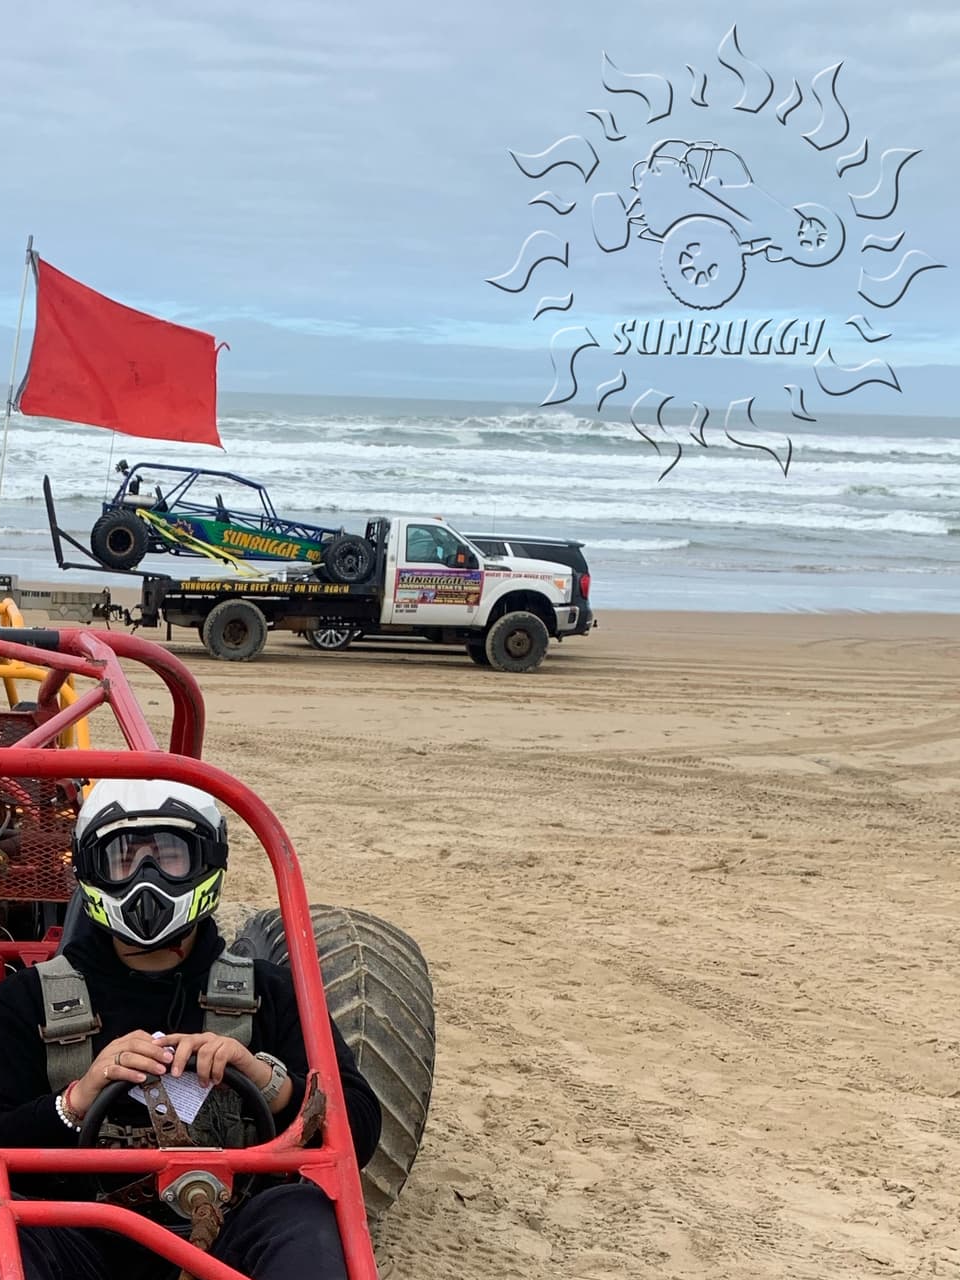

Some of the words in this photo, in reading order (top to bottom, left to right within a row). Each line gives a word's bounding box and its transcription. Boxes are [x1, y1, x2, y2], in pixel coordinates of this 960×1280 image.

[223, 530, 301, 559] SUNBUGGIE
[180, 582, 220, 591] SUNBUGGY
[234, 583, 248, 592] THE
[250, 583, 270, 592] BEST
[294, 584, 307, 592] ON
[324, 584, 350, 593] BEACH
